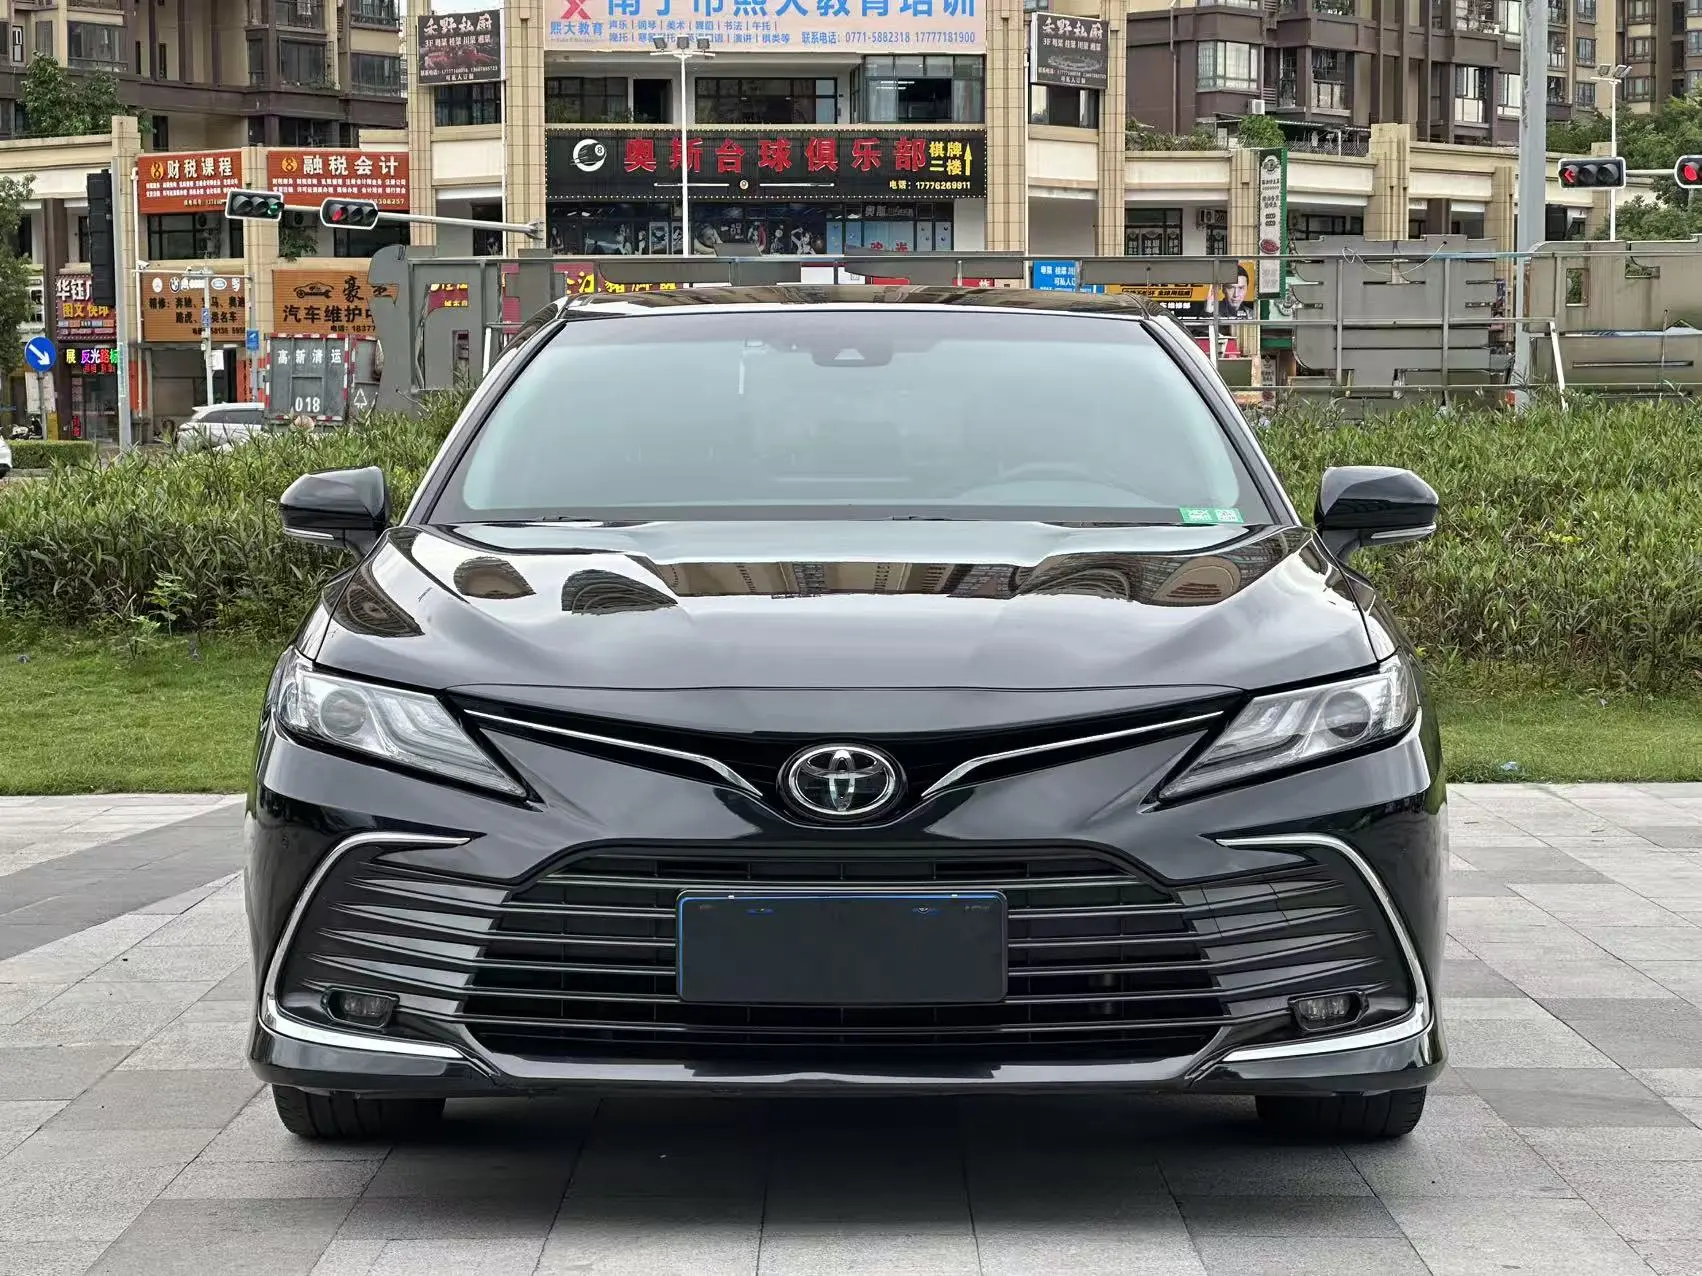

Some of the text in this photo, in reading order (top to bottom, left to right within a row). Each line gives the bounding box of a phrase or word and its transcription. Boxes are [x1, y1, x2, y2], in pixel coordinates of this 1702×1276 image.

[550, 21, 604, 35] 熙大教育
[609, 20, 627, 30] 声乐
[637, 20, 656, 30] 钢琴
[666, 20, 686, 30] 美术
[724, 20, 742, 31] 书法
[752, 21, 770, 31] 午托
[733, 33, 752, 43] 演讲
[915, 31, 975, 43] 17777181900
[624, 136, 926, 172] 奥斯台球俱乐部
[929, 141, 962, 158] 棋牌
[167, 157, 233, 179] 财税课程
[303, 154, 398, 175] 融税会计
[929, 159, 962, 175] 二楼
[176, 311, 238, 324] 路虎、类名车
[66, 348, 76, 364] 展
[278, 349, 342, 365] 高新清运
[295, 396, 320, 412] 018
